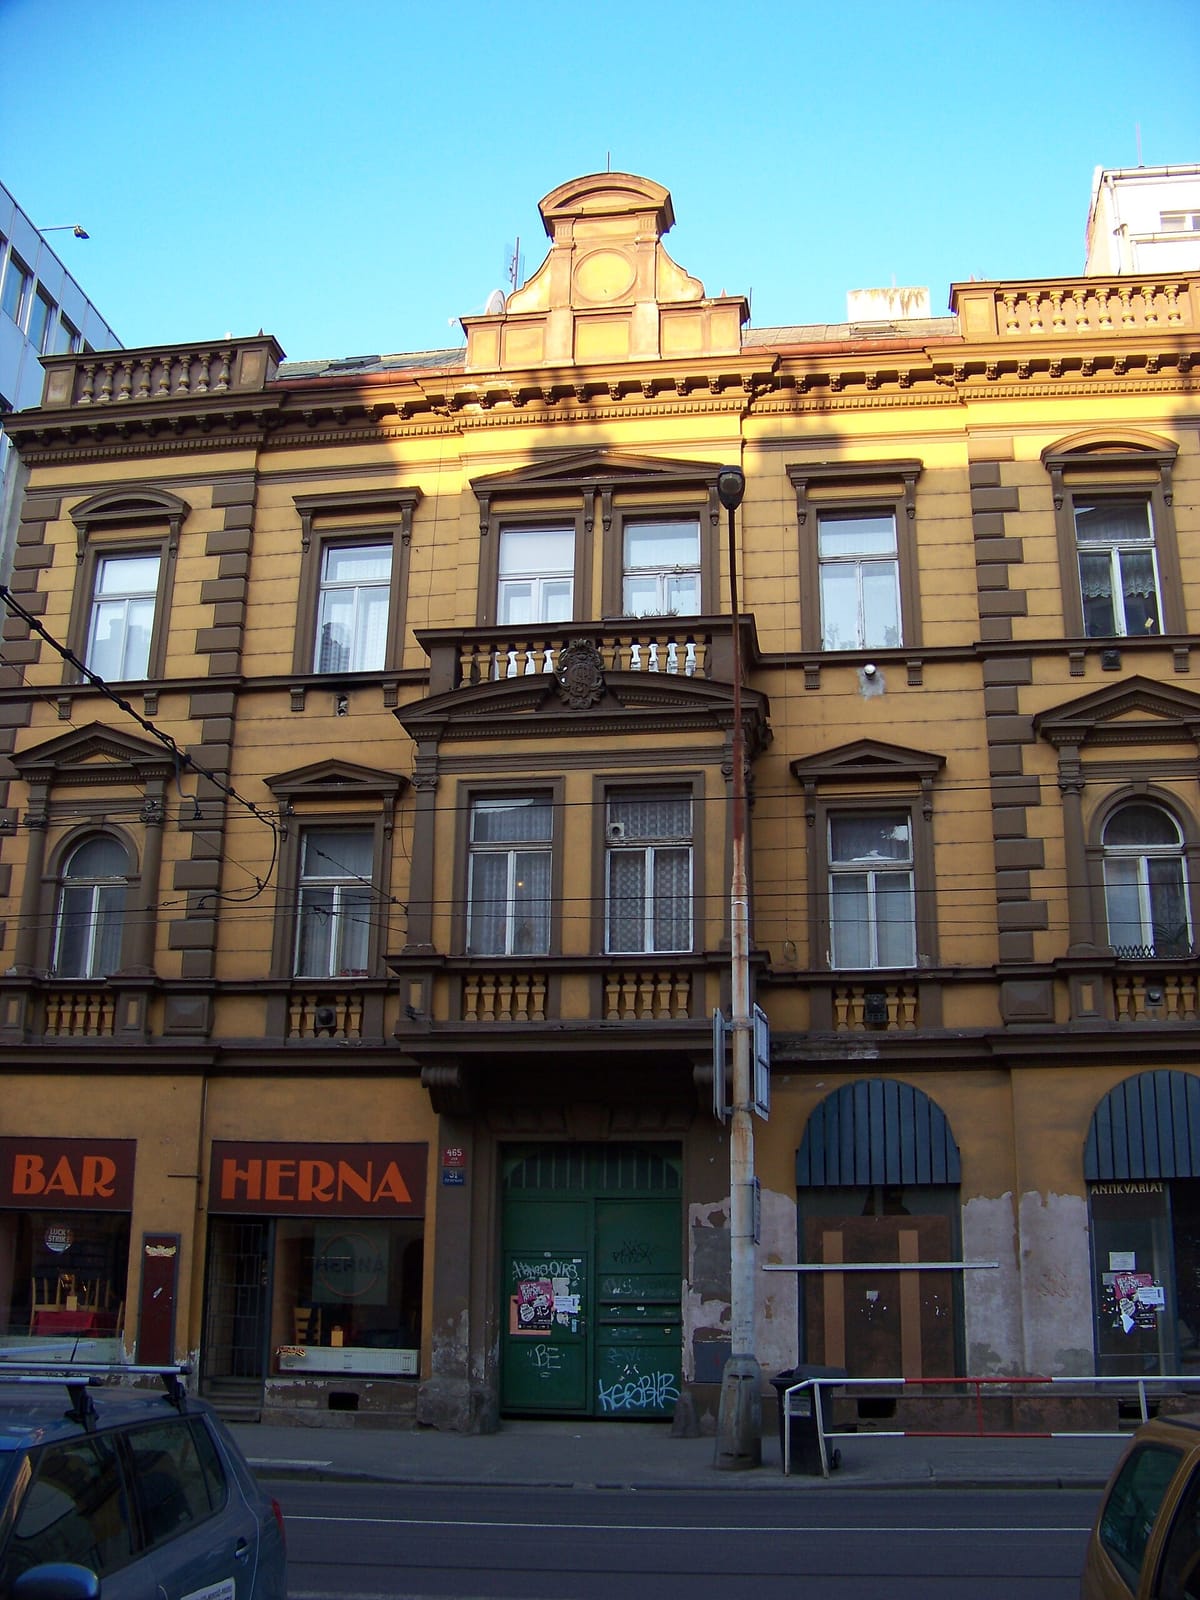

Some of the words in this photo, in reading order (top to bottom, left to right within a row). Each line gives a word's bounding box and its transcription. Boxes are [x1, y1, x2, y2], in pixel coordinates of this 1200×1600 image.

[446, 1148, 462, 1157] 465
[12, 1154, 117, 1197] BAR
[221, 1159, 412, 1203] HERNA
